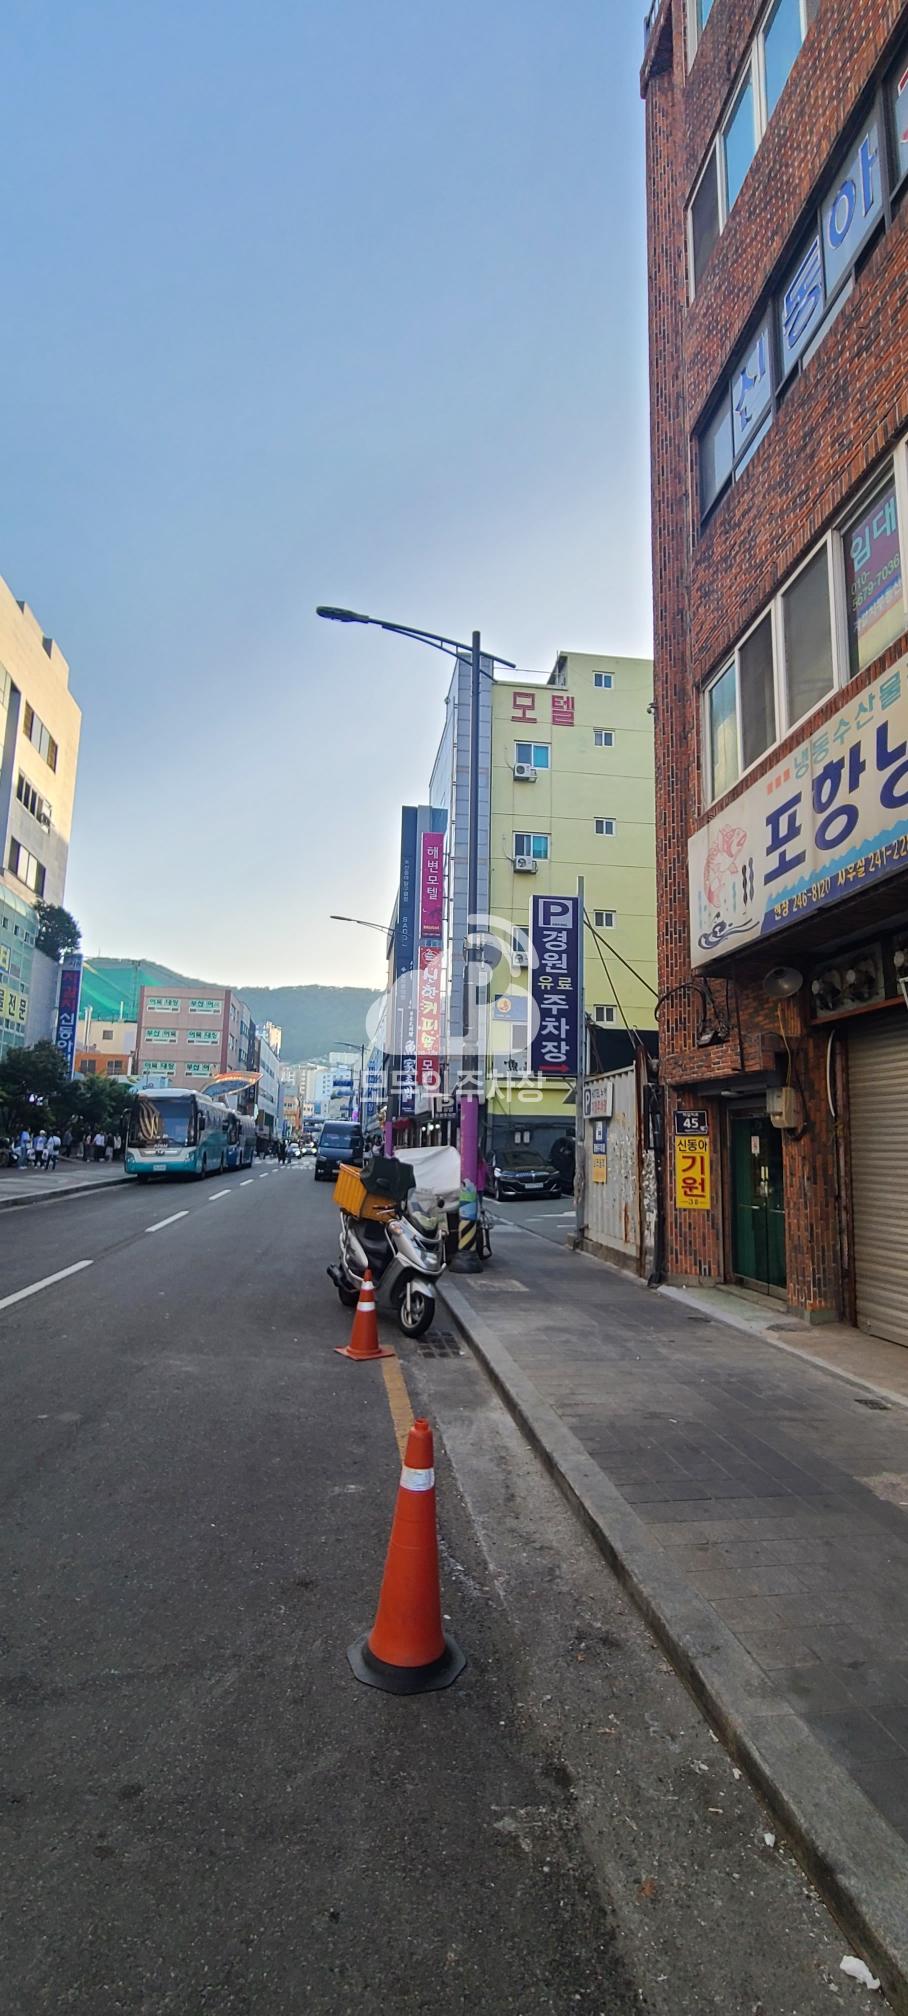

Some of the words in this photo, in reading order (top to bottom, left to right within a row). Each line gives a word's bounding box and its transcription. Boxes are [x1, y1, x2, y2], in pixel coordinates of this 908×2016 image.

[734, 132, 877, 432] 신동아
[851, 498, 896, 572] 임대
[852, 553, 900, 612] 5679-7036
[511, 692, 575, 728] 모텔
[794, 671, 902, 781] 냉동수산물
[425, 846, 440, 900] 해변모텔
[792, 876, 831, 912] 246-8120
[869, 834, 908, 872] 241-22
[542, 900, 570, 926] P
[542, 930, 568, 974] 경원
[538, 976, 573, 991] 유료
[540, 994, 570, 1063] 주차장
[677, 1139, 708, 1152] 신동아
[683, 1118, 699, 1128] 45
[681, 1156, 706, 1198] 기원
